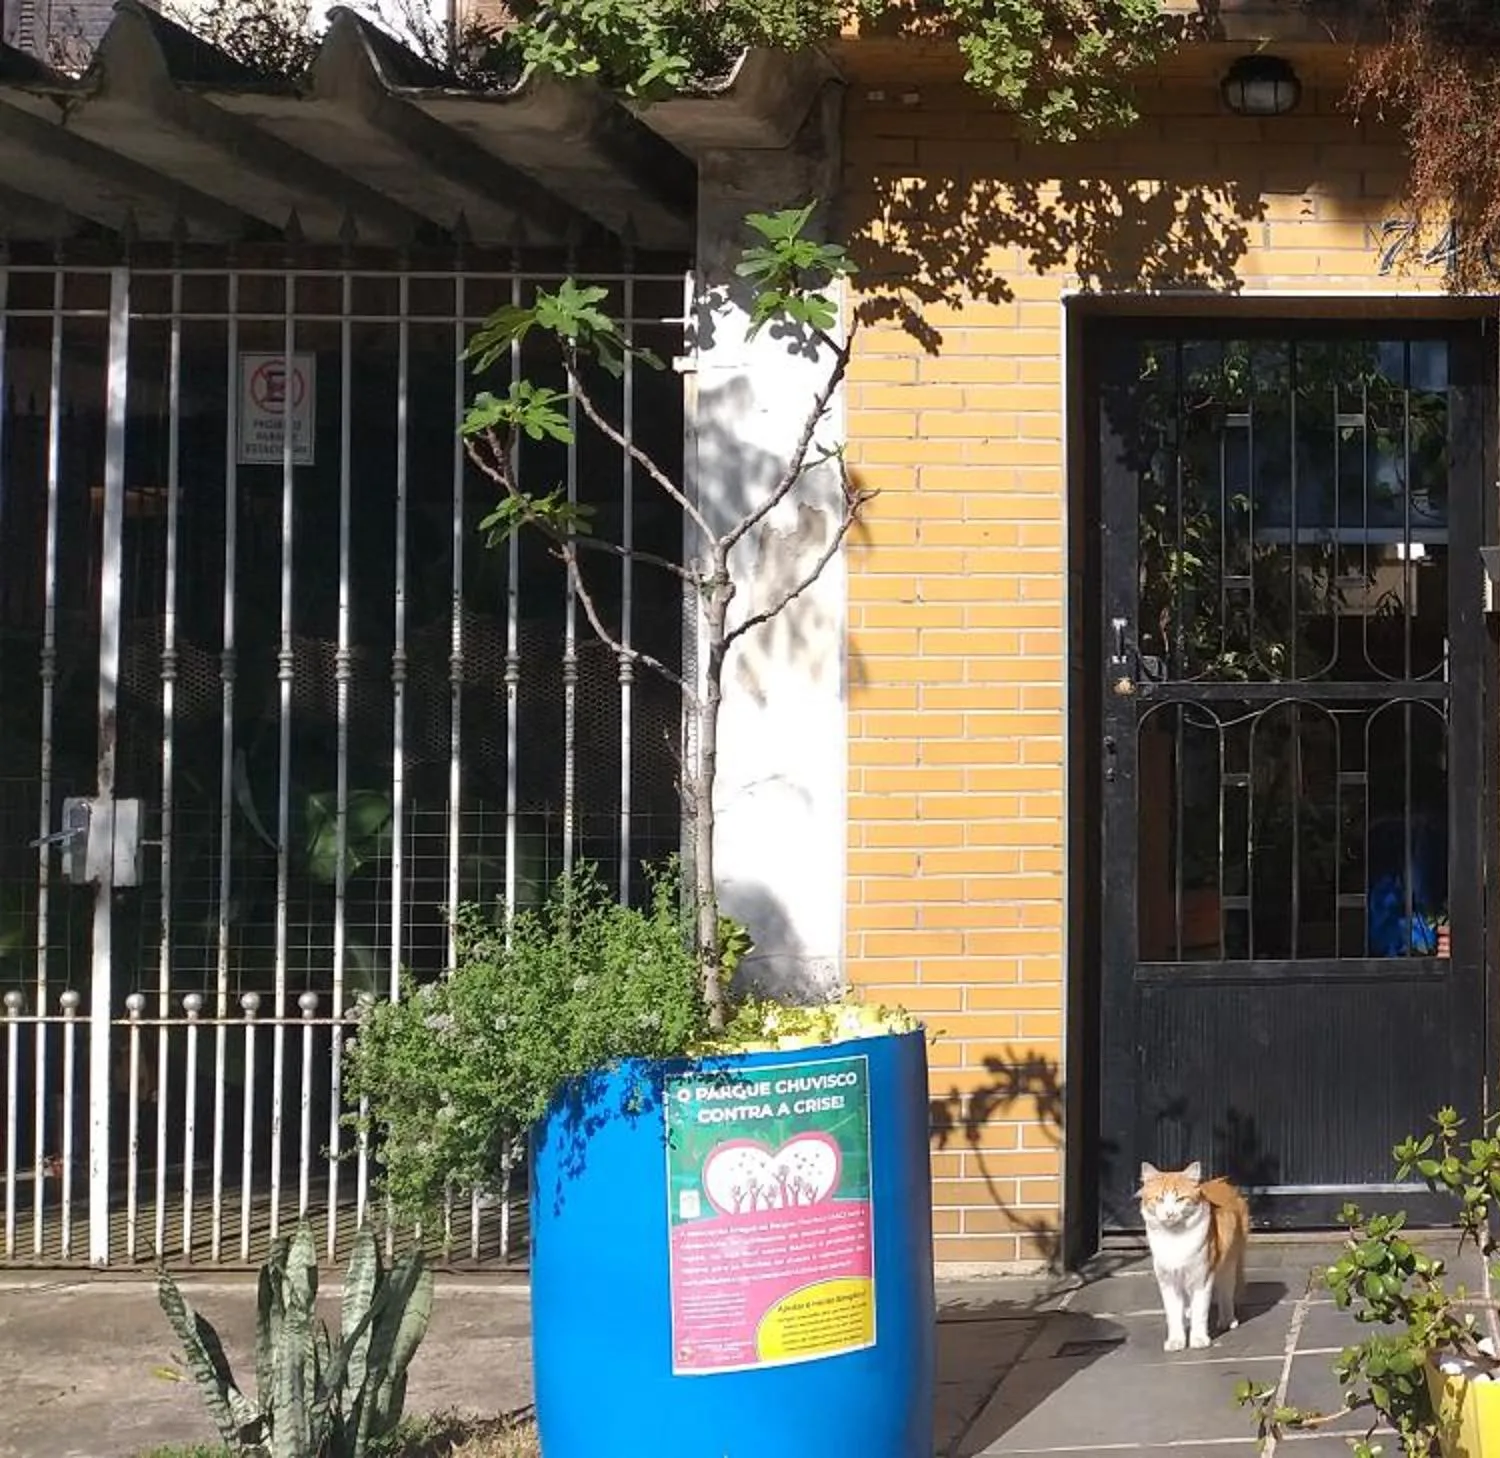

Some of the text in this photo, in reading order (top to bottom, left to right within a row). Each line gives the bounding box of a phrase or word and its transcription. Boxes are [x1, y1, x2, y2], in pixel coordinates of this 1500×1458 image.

[677, 1071, 857, 1102] O PARQUE CHUVISCO
[698, 1095, 845, 1123] CONTRA A CRISE!
